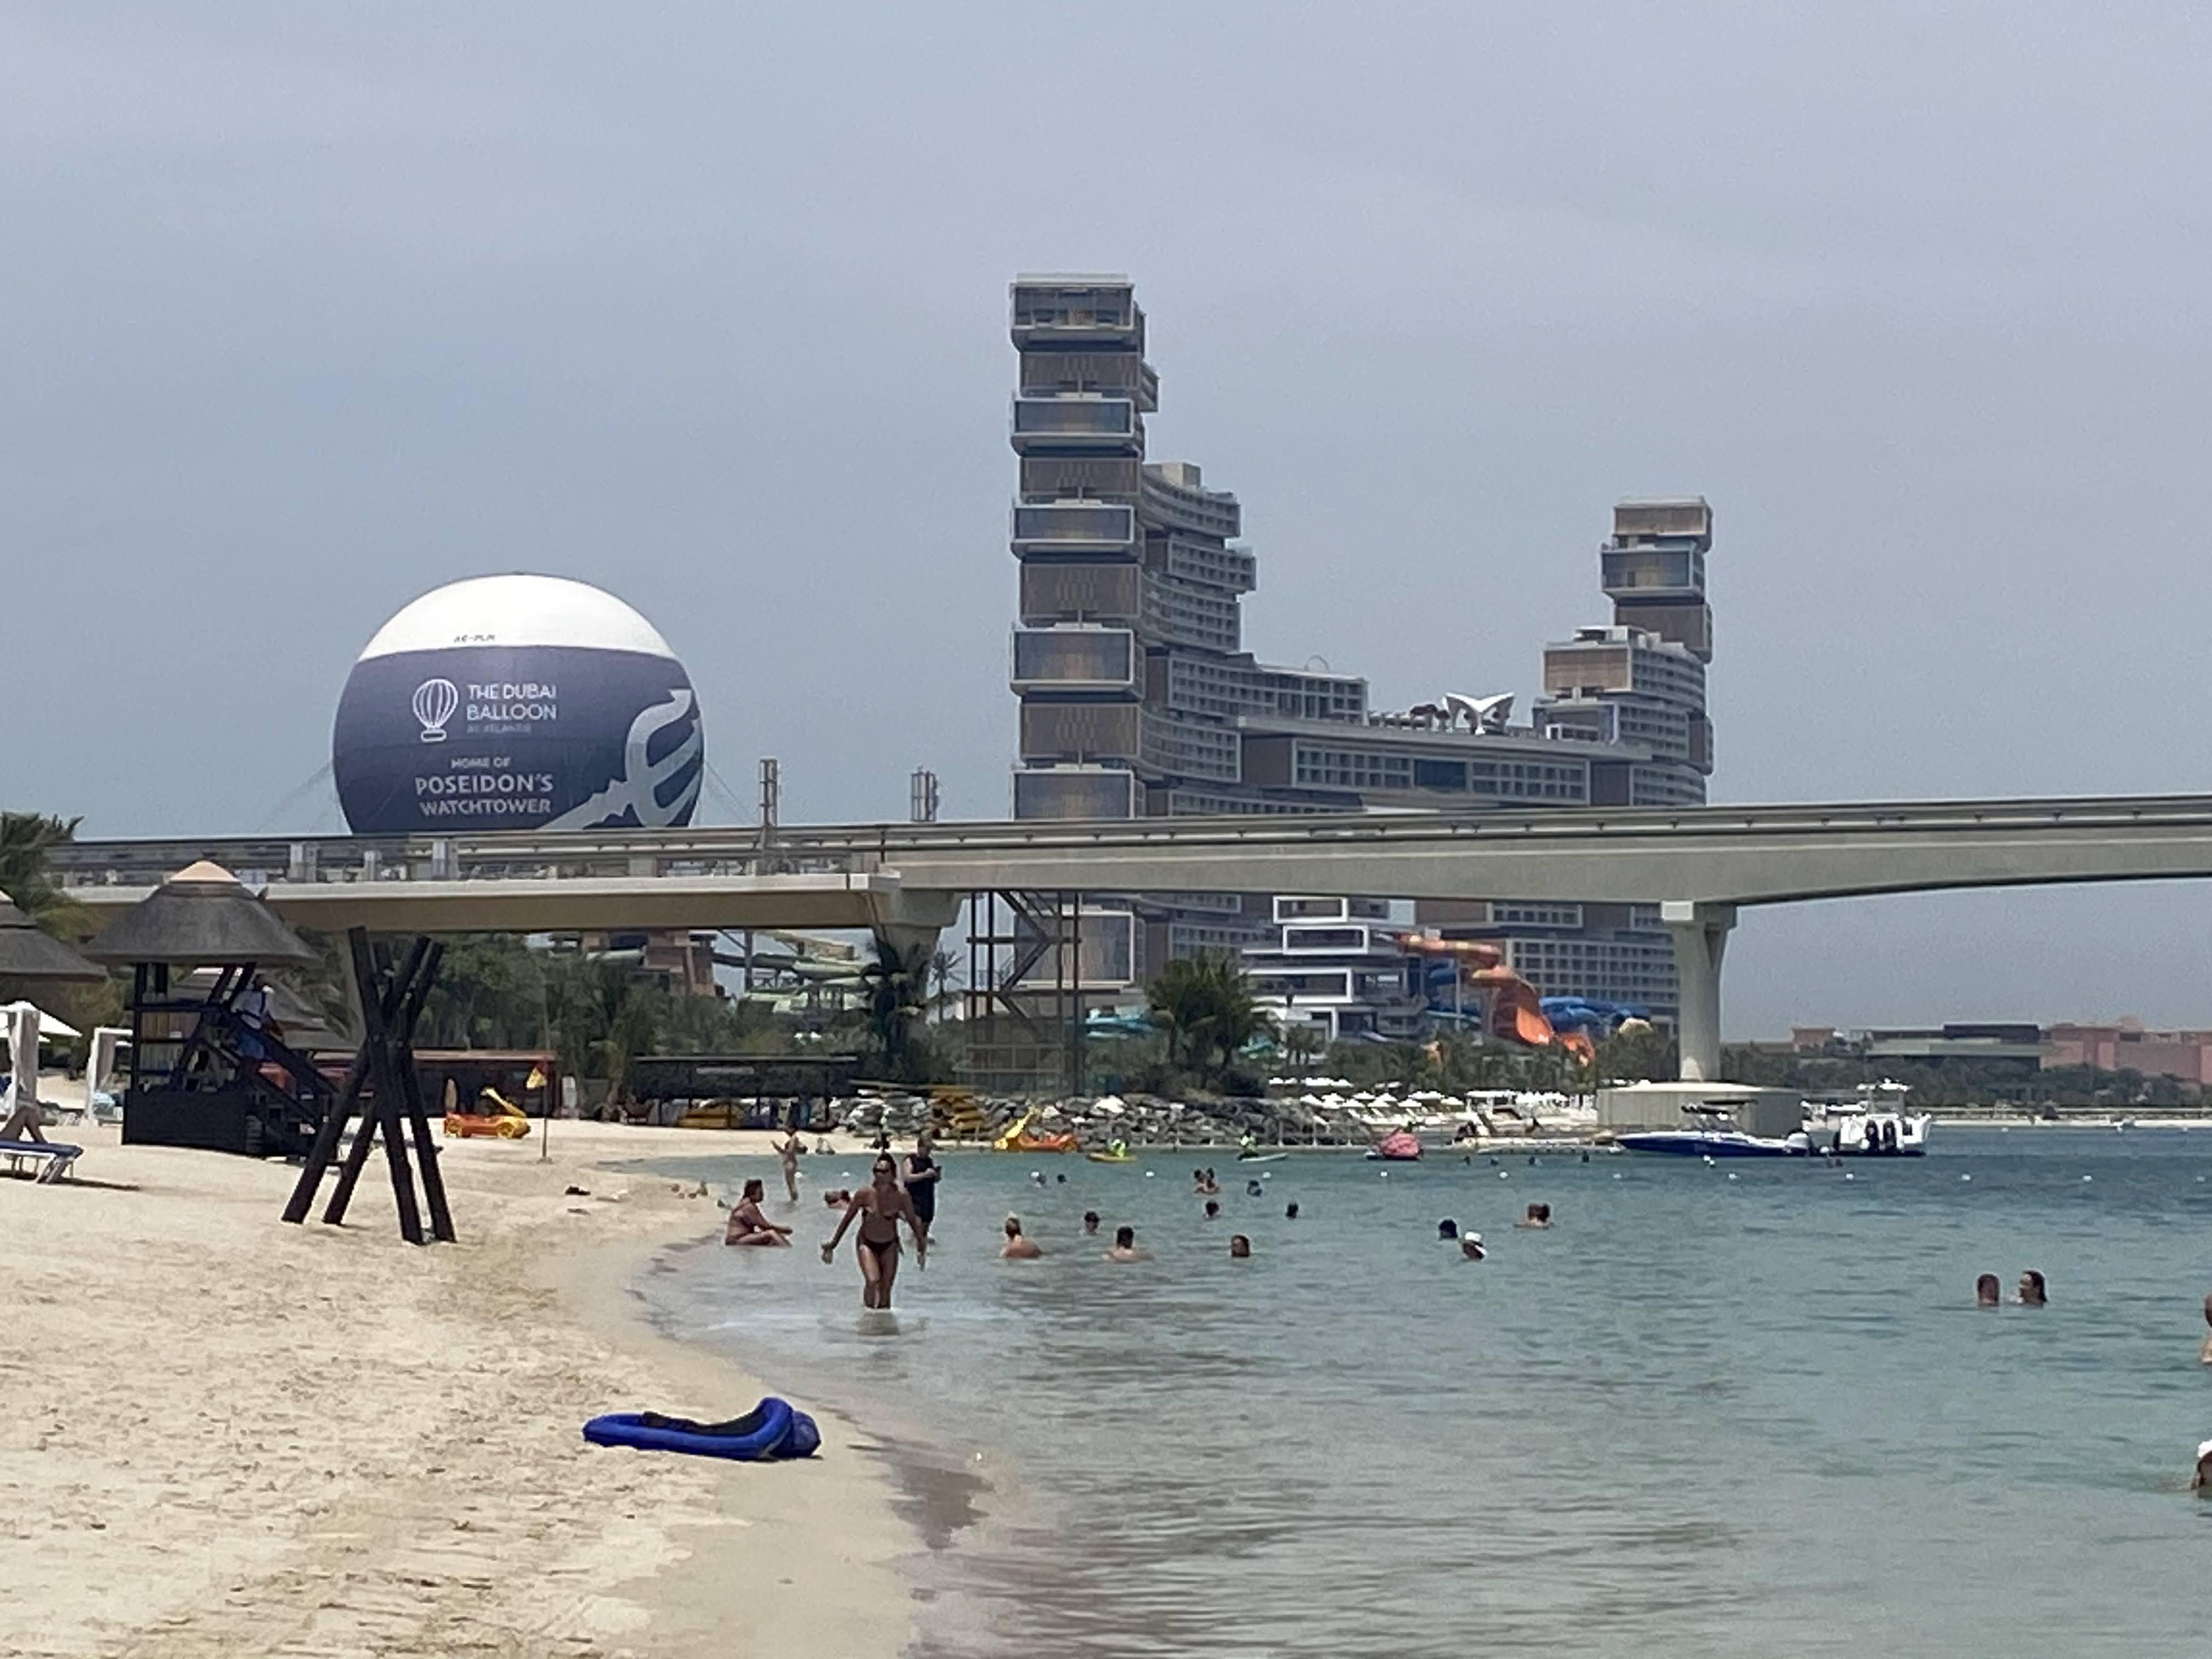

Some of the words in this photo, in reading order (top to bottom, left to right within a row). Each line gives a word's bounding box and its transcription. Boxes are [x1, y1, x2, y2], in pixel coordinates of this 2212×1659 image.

[467, 684, 499, 699] THE
[503, 683, 556, 699] DUBAI
[467, 704, 556, 720] BALLOON
[452, 757, 490, 768] HOME
[494, 757, 511, 768] OF
[415, 774, 554, 795] POSEIDON'S
[419, 798, 551, 816] WATCHTOWER
